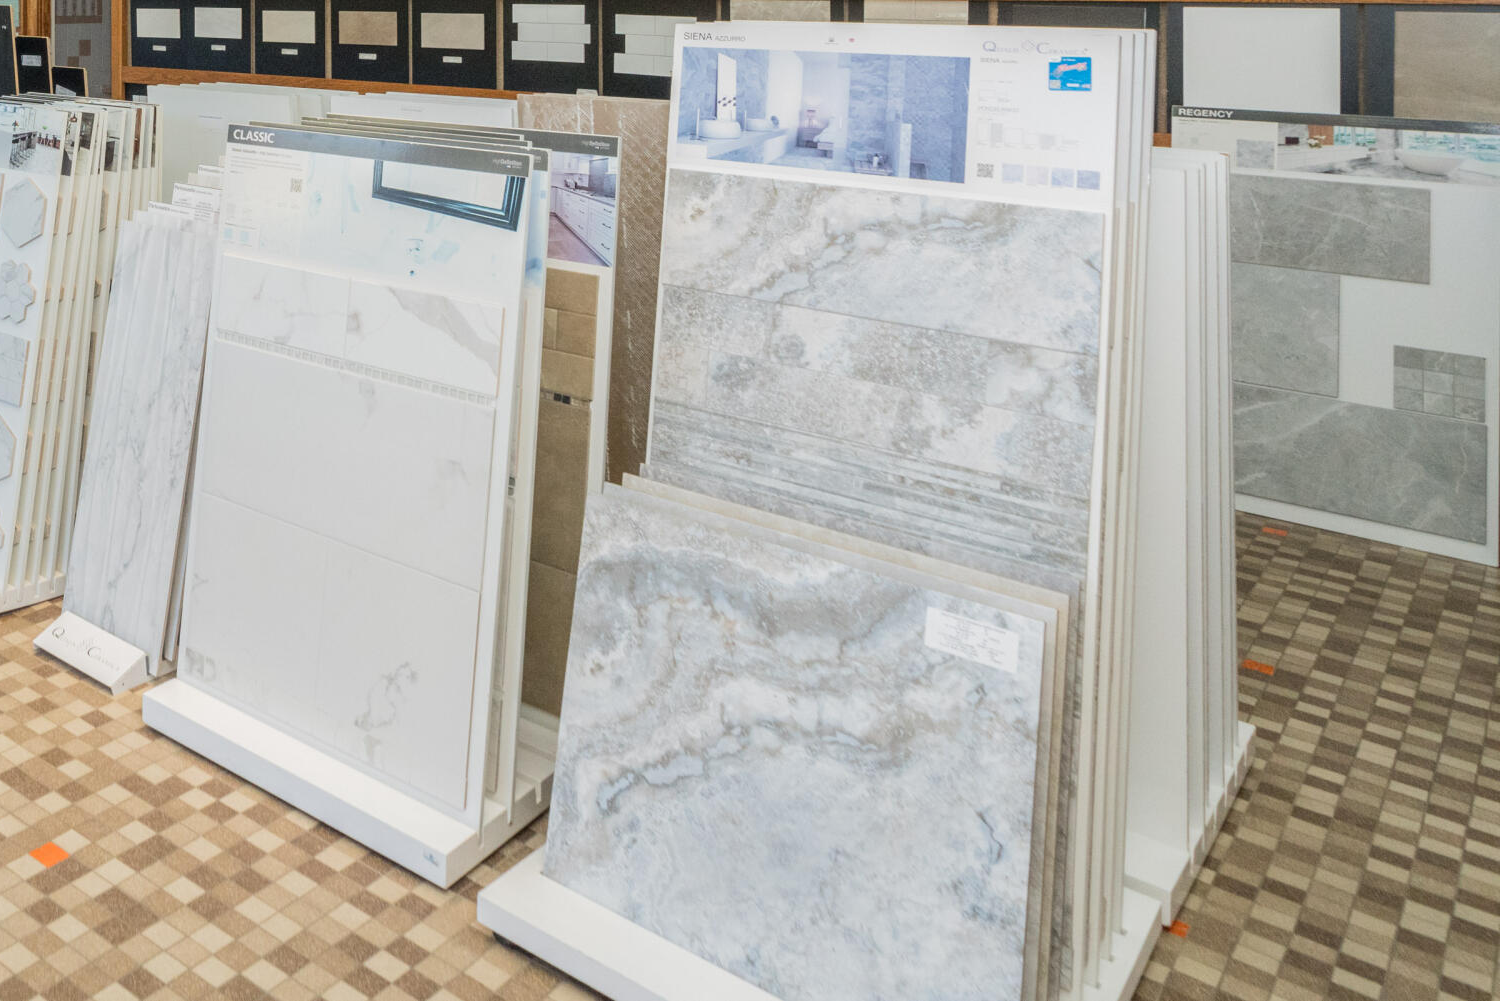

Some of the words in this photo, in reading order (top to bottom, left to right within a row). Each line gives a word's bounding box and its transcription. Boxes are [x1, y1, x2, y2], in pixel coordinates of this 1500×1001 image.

[683, 32, 713, 41] SIENA
[1178, 108, 1234, 118] REGENCY
[233, 128, 275, 144] CLASSIC
